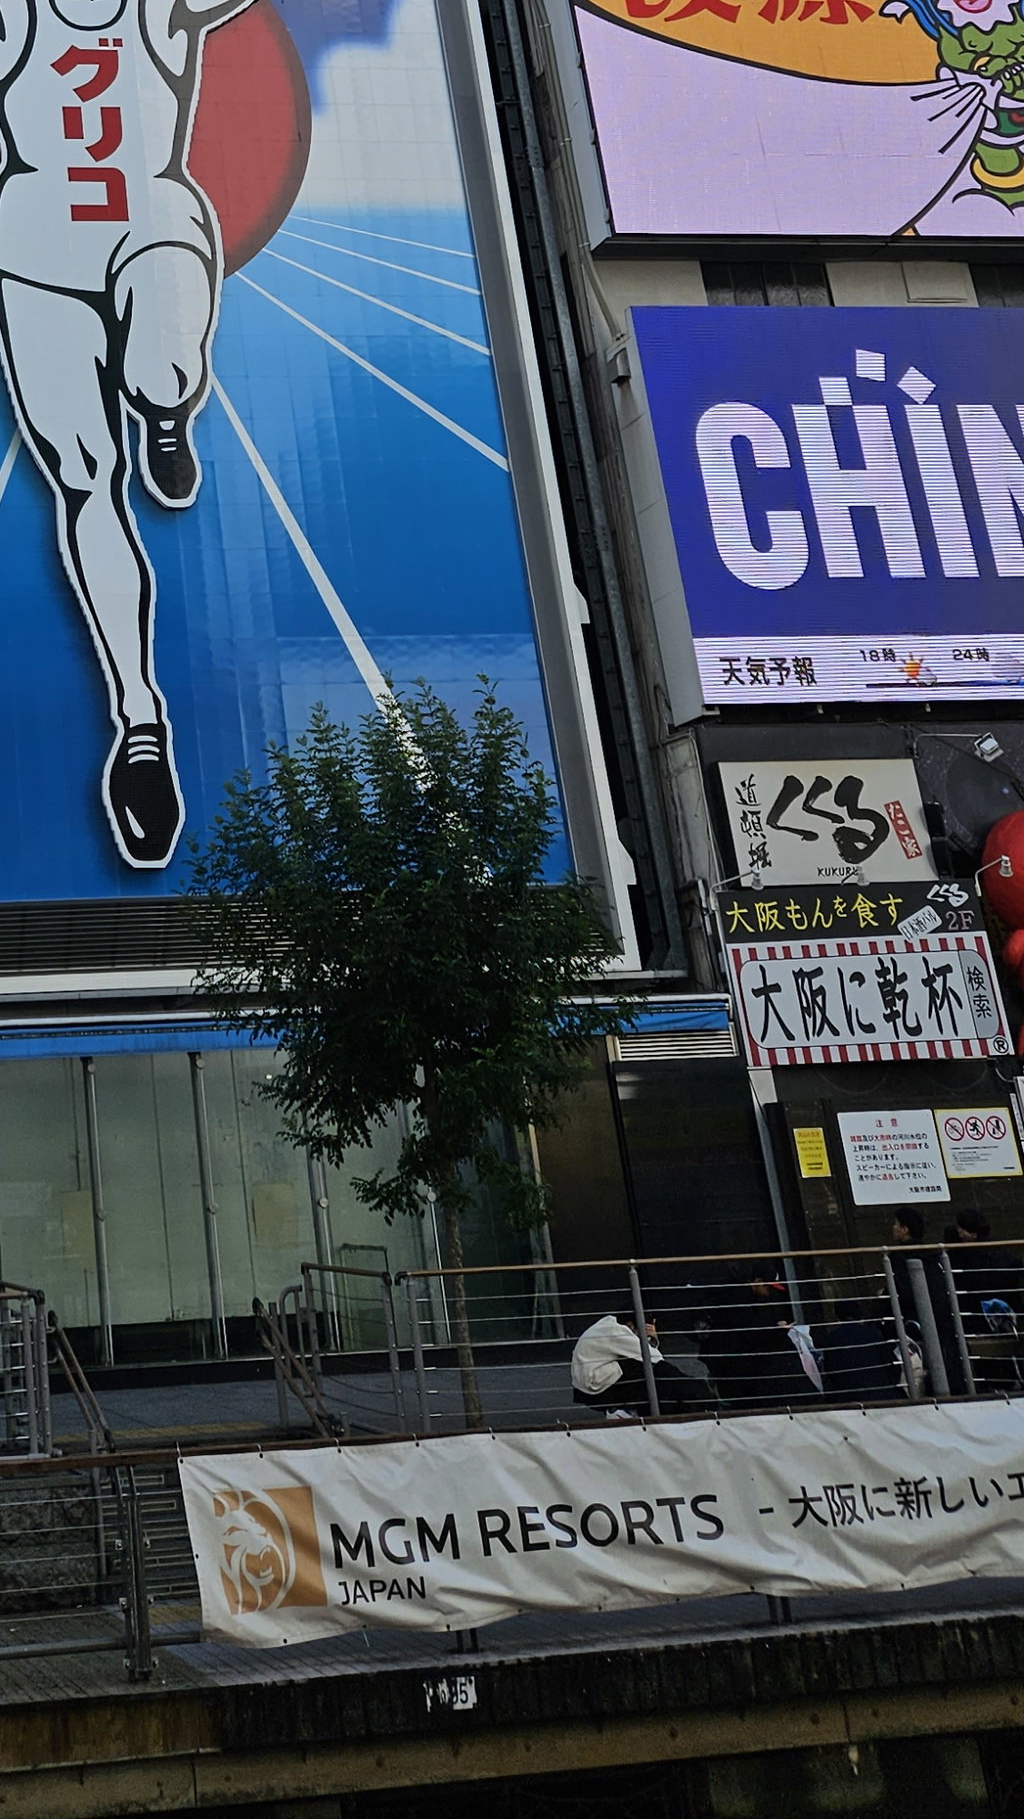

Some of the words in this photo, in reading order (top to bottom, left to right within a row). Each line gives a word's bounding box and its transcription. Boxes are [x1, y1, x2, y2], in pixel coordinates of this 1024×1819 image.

[50, 38, 130, 222] グリコ
[720, 655, 817, 687] 天気予報
[859, 647, 897, 662] 18時
[952, 647, 990, 662] 24時
[734, 773, 773, 869] 道頓堀
[766, 775, 890, 865] くくる
[726, 892, 904, 934] 大阪もんを食す
[945, 910, 975, 930] 2F
[751, 956, 964, 1043] 大阪に乾杯
[966, 965, 992, 1019] 検索
[329, 1513, 461, 1569] MGM
[477, 1493, 725, 1557] RESORTS
[340, 1576, 426, 1606] JAPAN
